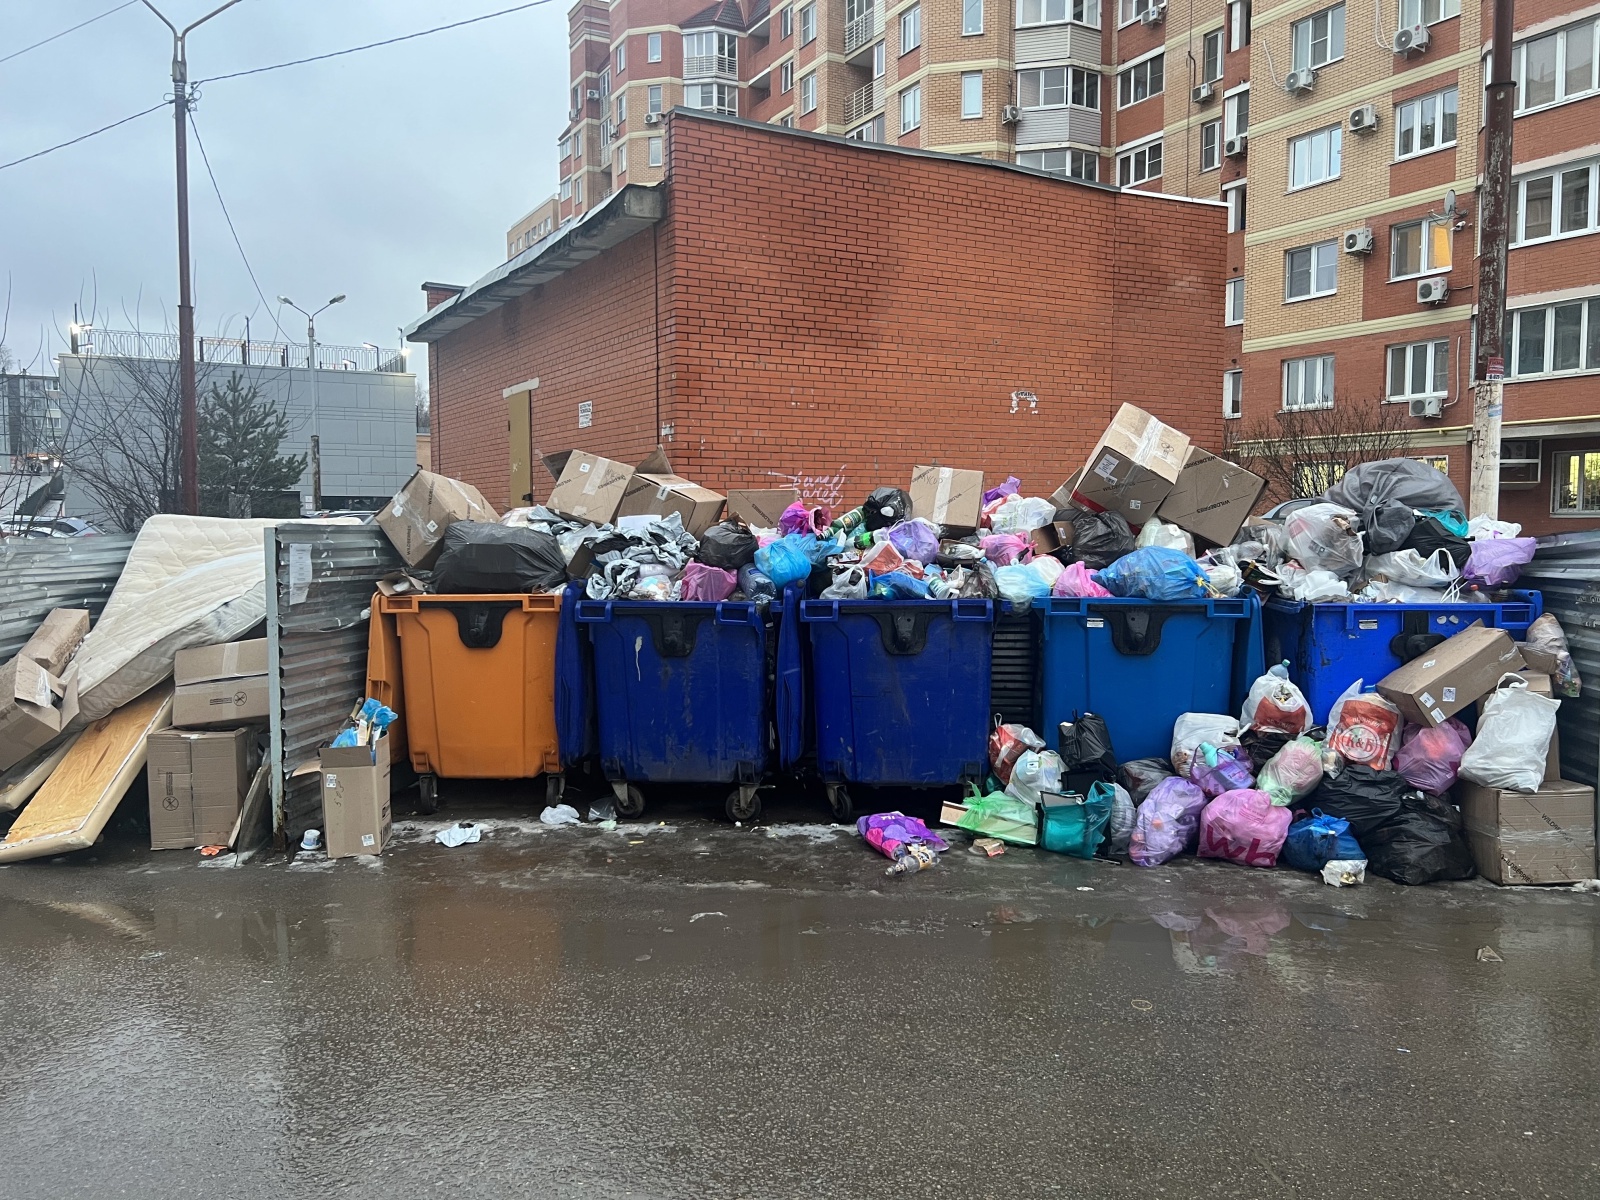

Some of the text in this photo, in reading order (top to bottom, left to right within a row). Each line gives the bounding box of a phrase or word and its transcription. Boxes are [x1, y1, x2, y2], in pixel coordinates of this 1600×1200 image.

[1183, 455, 1217, 470] WILDBERRIES
[625, 482, 653, 498] WILDBERRIES
[1196, 499, 1231, 514] WILDBERRIES
[751, 503, 775, 526] WILDBERRIES
